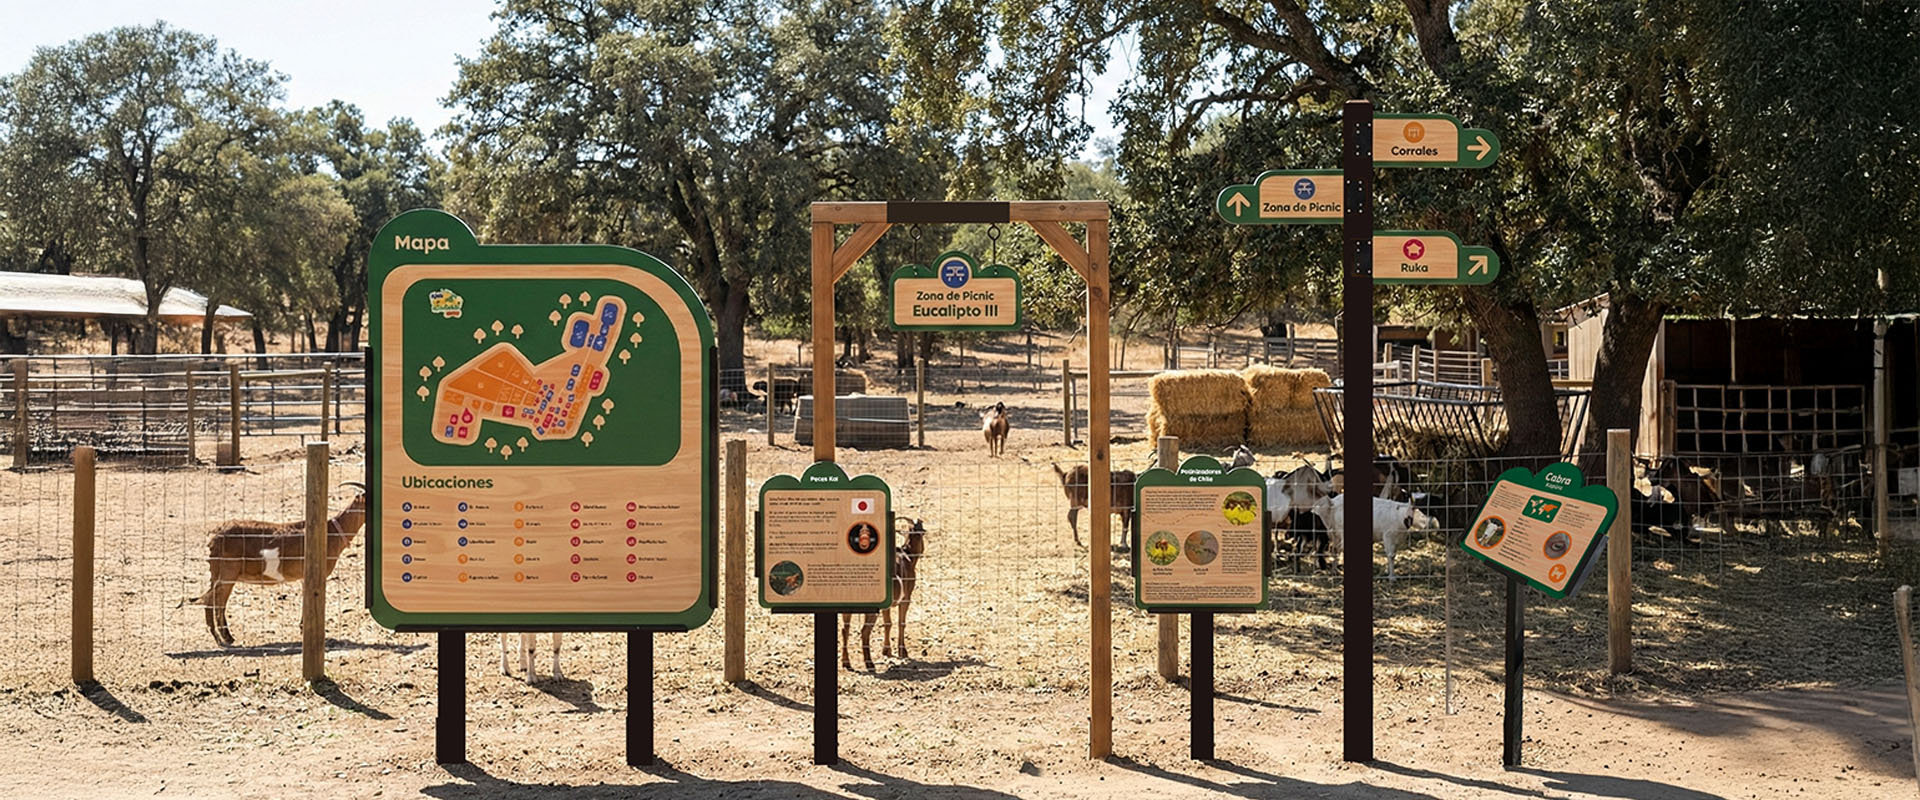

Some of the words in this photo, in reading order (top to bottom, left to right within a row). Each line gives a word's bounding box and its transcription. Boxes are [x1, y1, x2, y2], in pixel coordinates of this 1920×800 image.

[1391, 145, 1438, 157] Corrales
[1263, 203, 1291, 213] Zona
[1293, 202, 1307, 213] de
[1309, 202, 1341, 213] Picnic
[394, 235, 450, 254] Mapa
[1400, 262, 1429, 273] Ruka
[916, 291, 944, 301] Zona
[946, 291, 961, 301] de
[963, 291, 995, 301] Picnic
[913, 304, 981, 320] Eucalipto
[985, 304, 998, 317] III
[402, 475, 494, 489] Ubicaciones
[1545, 472, 1572, 486] Cabra
